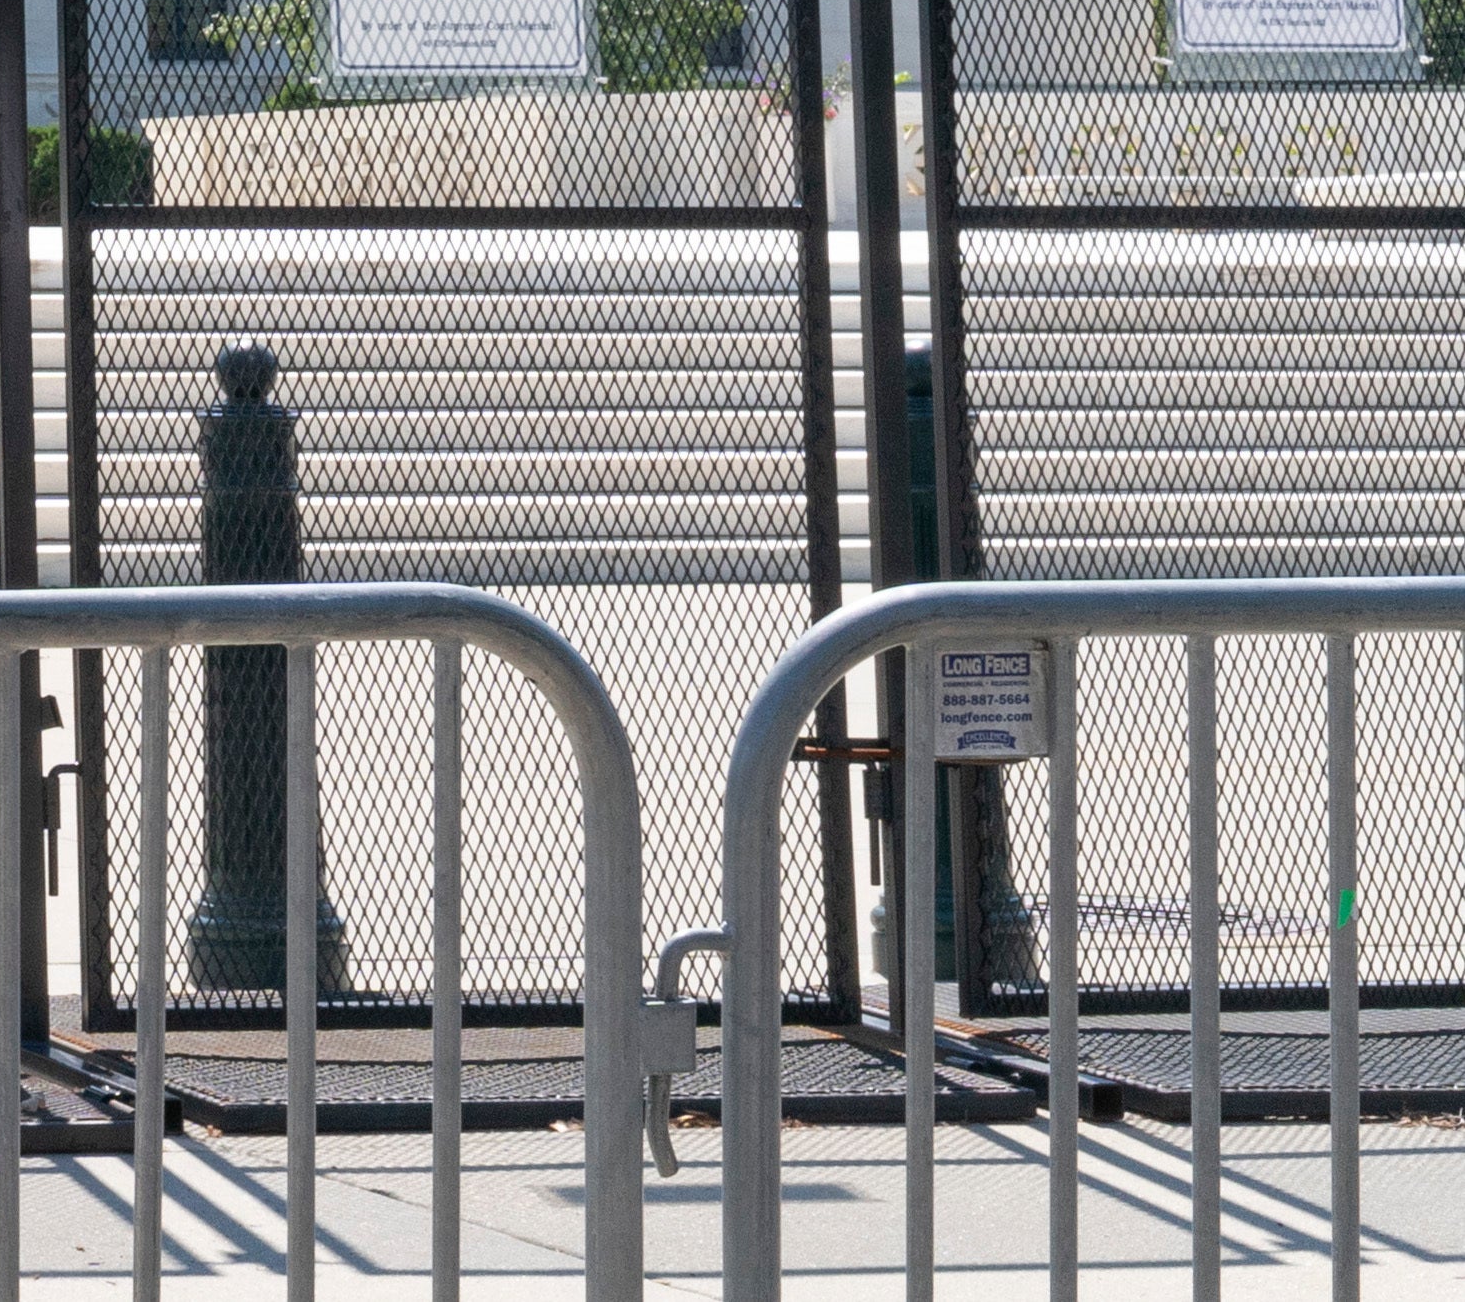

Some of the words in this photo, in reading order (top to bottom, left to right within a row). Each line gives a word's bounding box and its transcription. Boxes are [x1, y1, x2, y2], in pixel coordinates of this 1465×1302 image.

[945, 655, 982, 675] LONG
[985, 654, 1027, 675] FENCE
[942, 693, 1030, 706] 888-887-5664
[940, 711, 1033, 726] longfence.com
